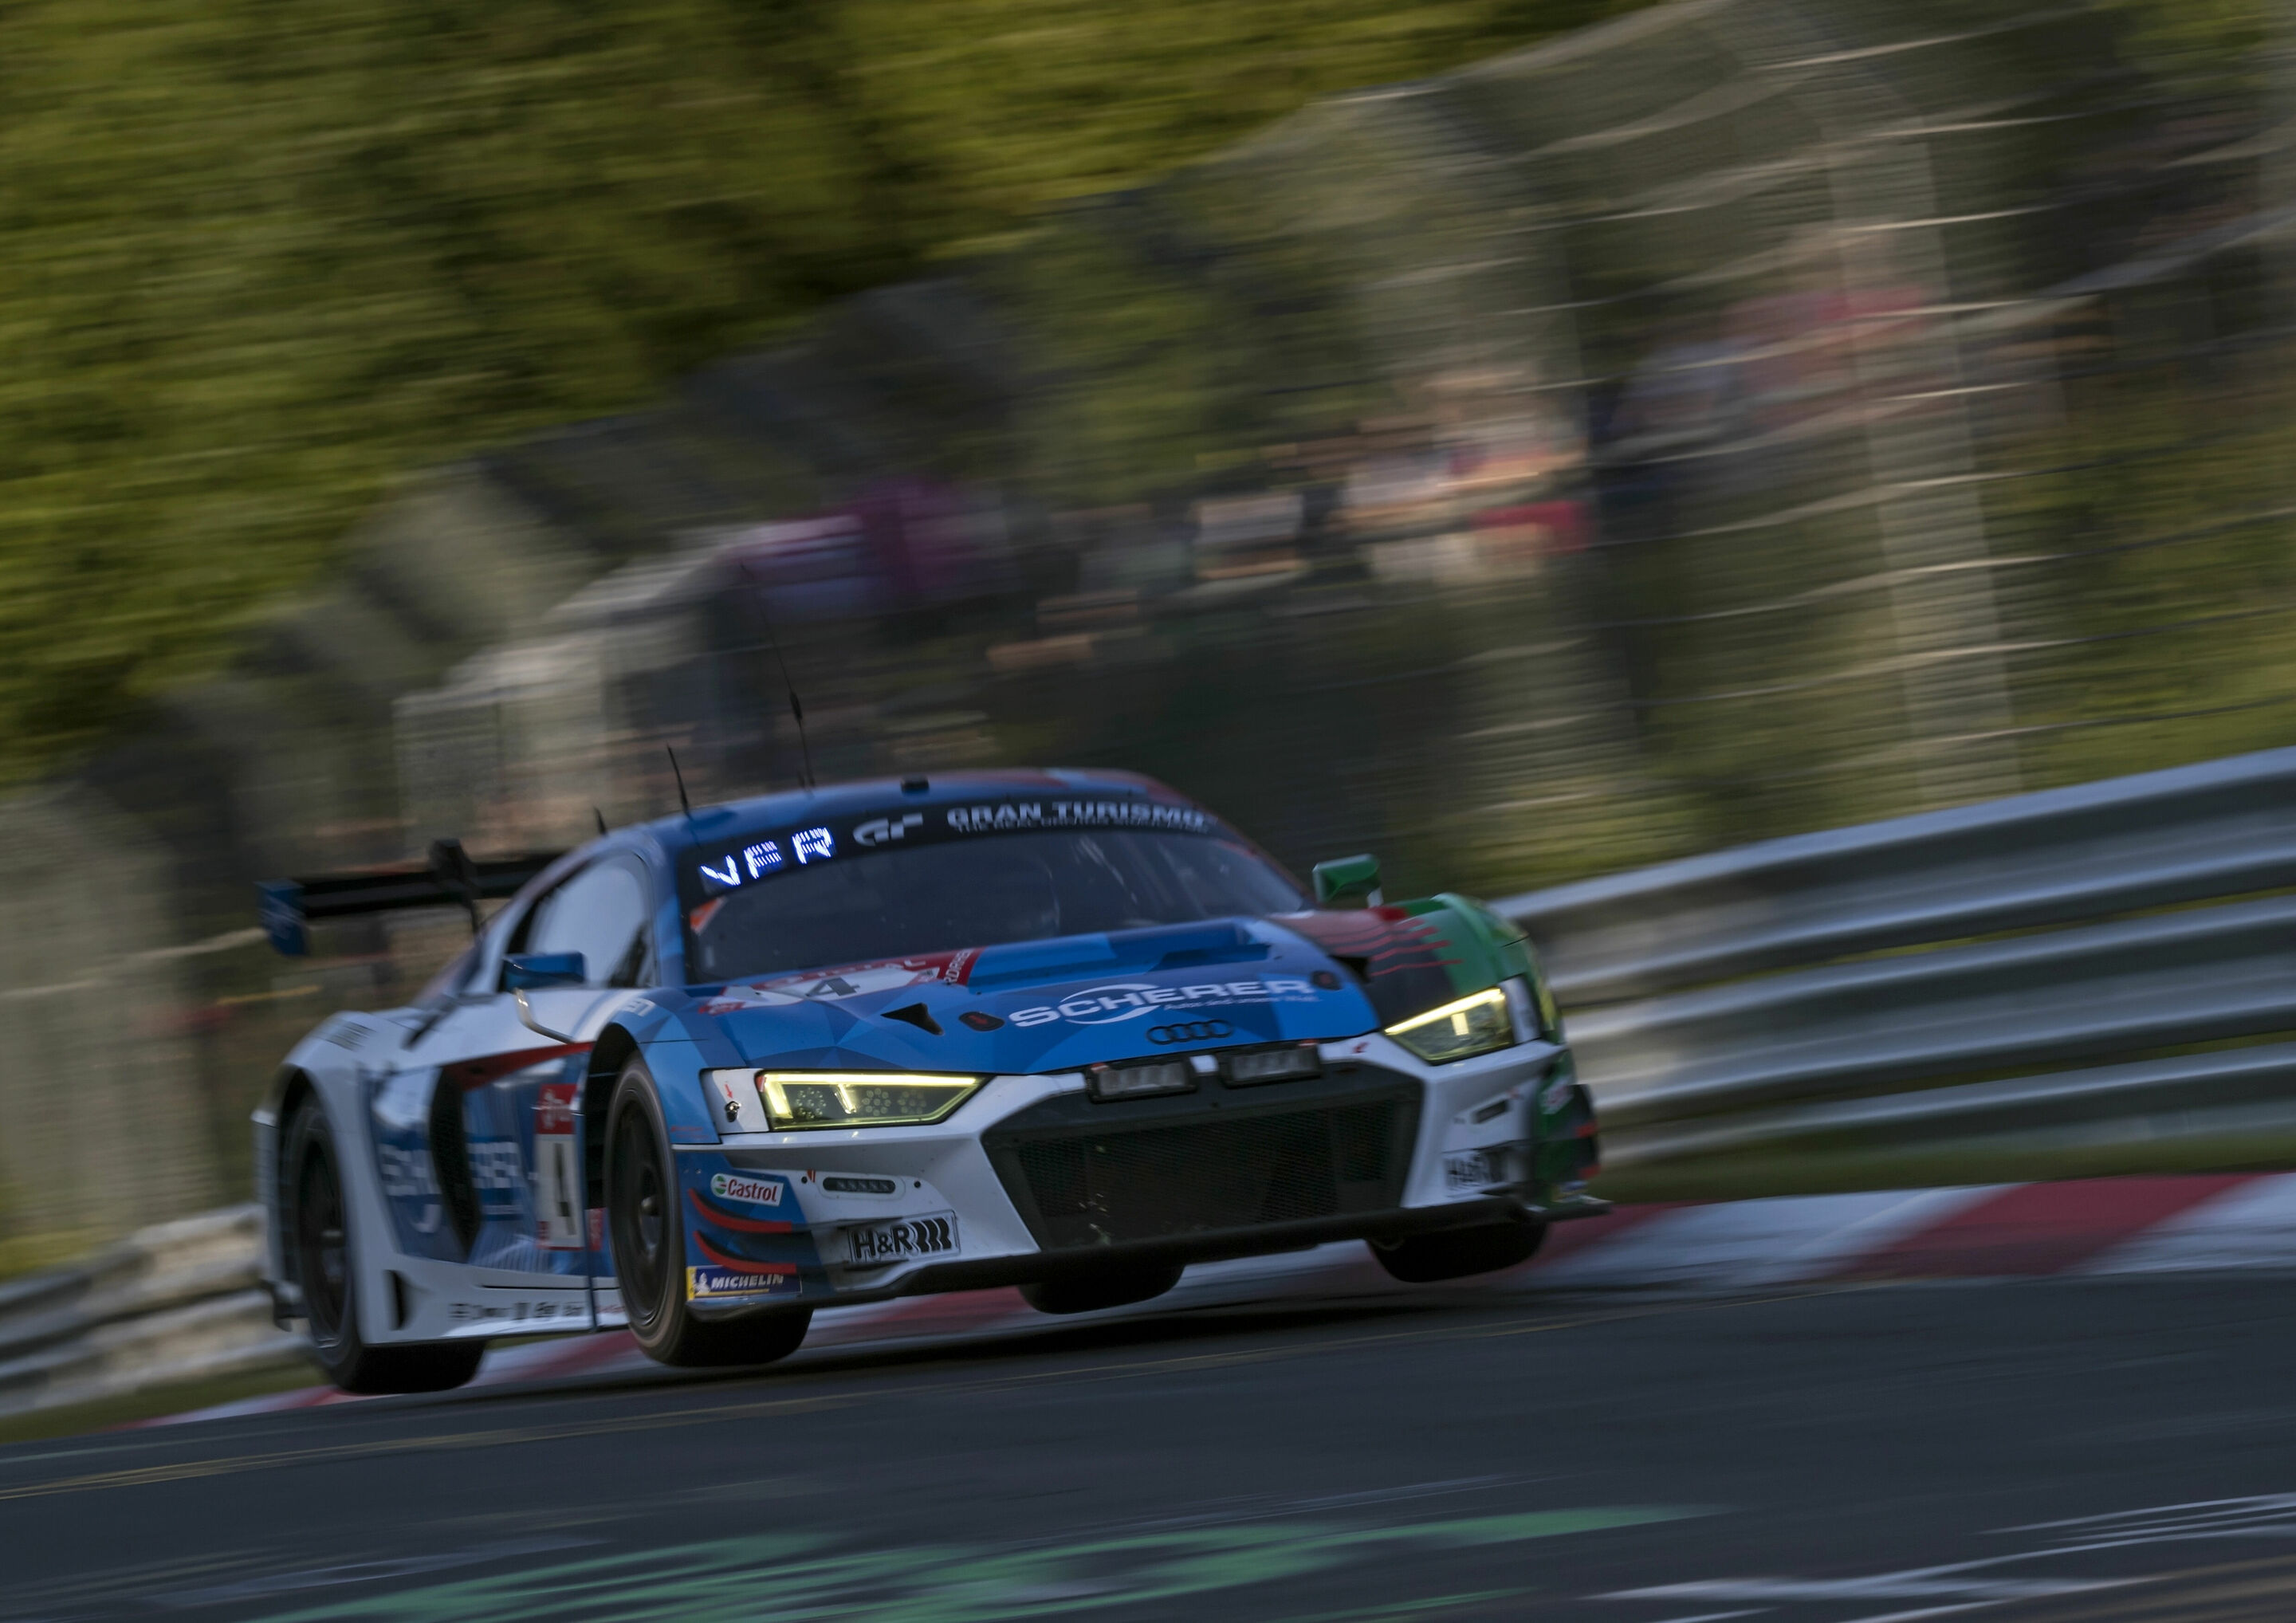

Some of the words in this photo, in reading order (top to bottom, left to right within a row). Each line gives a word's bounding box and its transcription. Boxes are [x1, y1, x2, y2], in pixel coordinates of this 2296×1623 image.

[946, 802, 1041, 828] GRAN
[1008, 980, 1315, 1028] SCHERER
[728, 1179, 778, 1203] Castrol
[852, 1225, 914, 1259] H&R
[711, 1274, 784, 1290] MICHELIN
